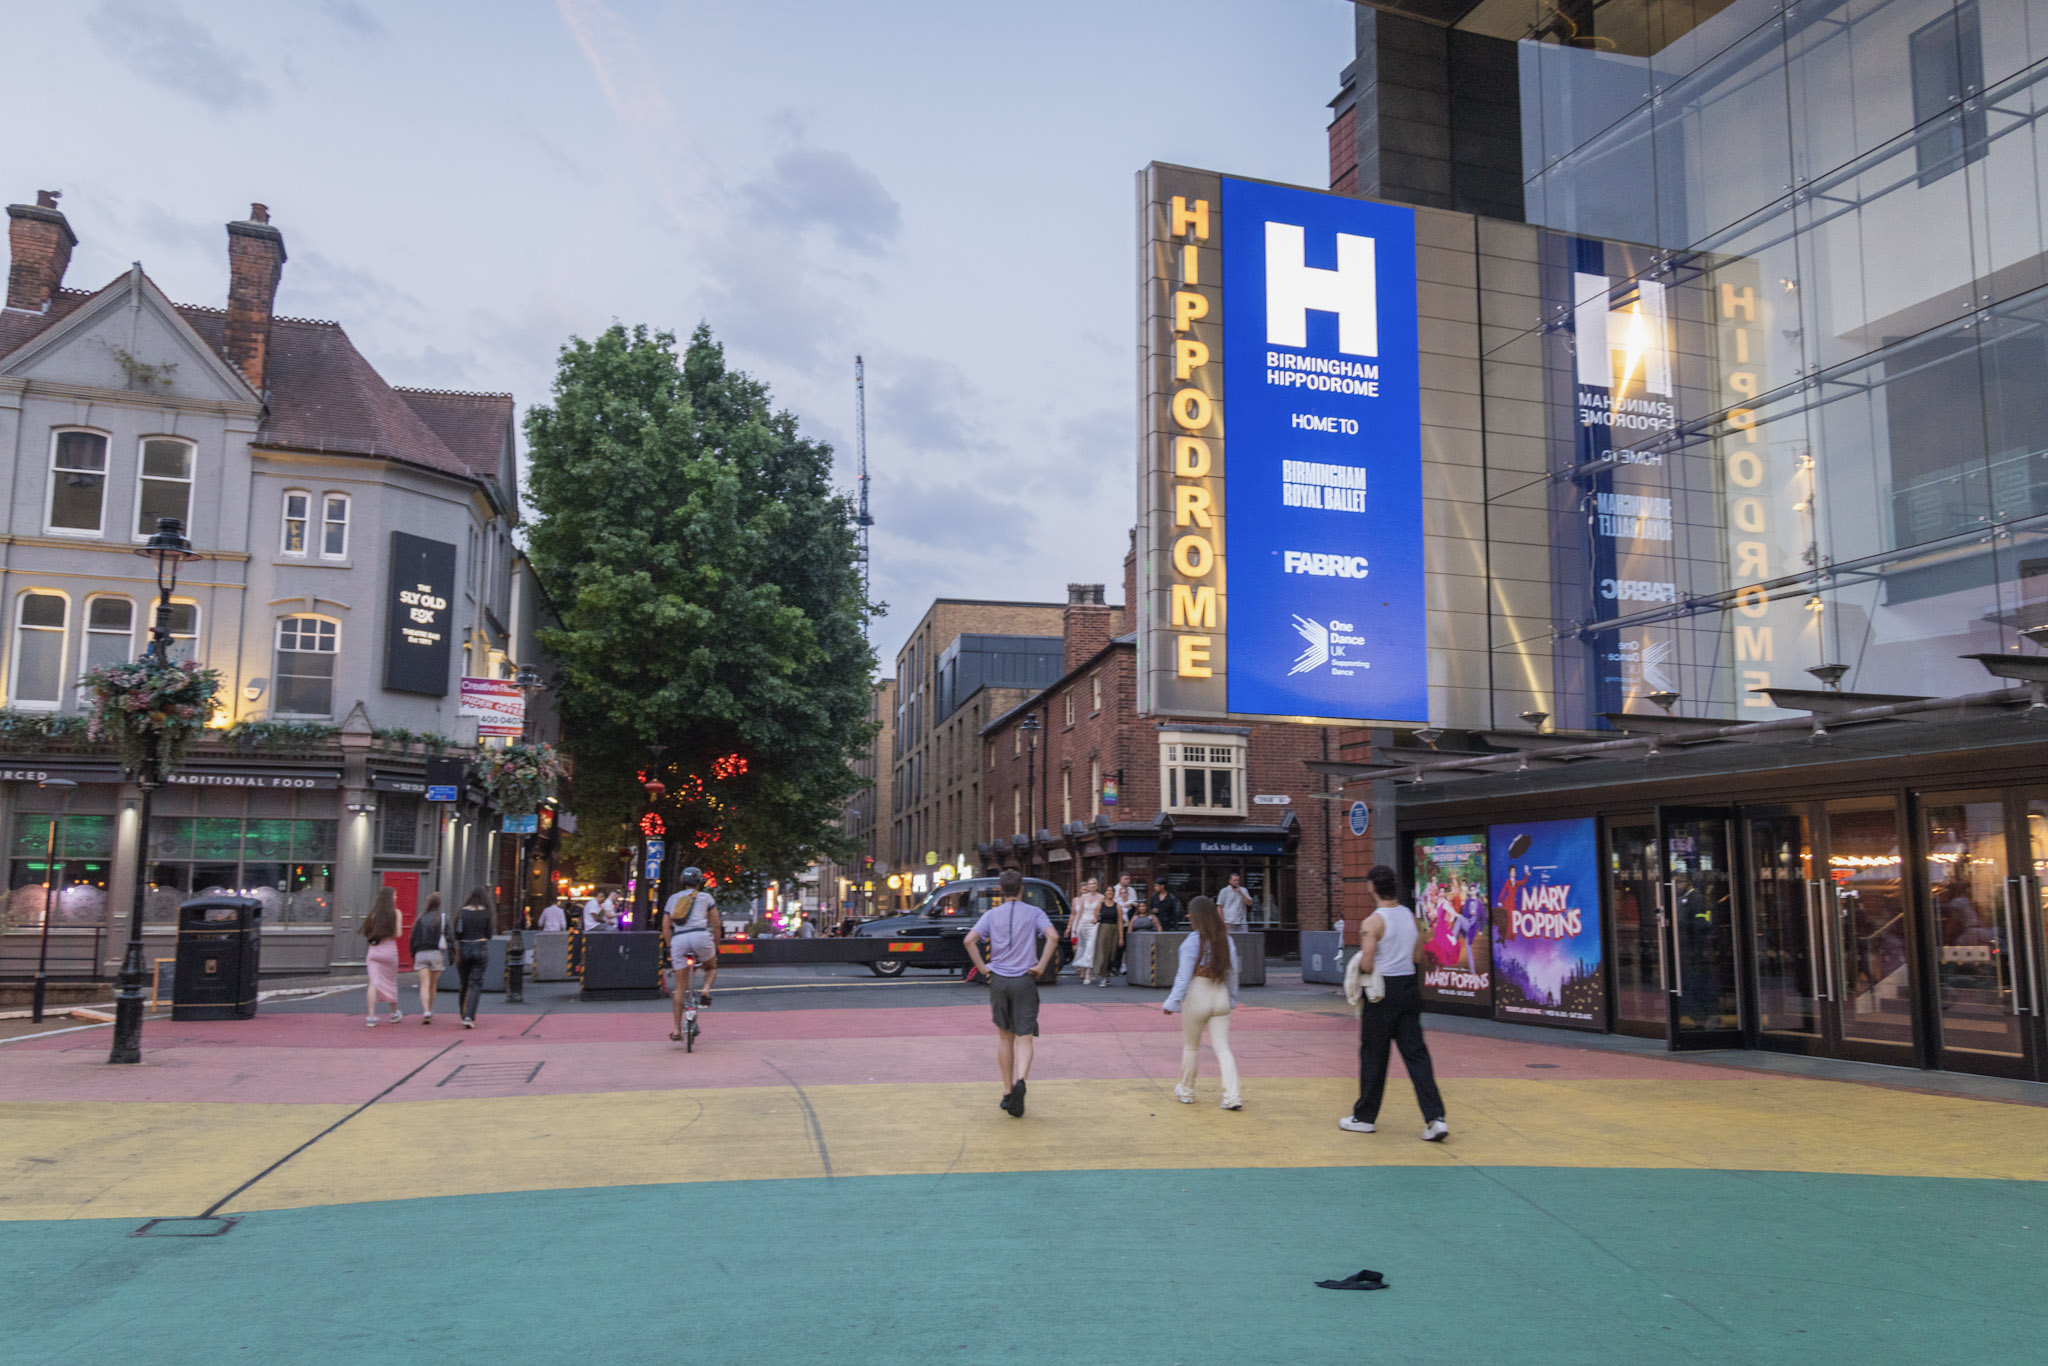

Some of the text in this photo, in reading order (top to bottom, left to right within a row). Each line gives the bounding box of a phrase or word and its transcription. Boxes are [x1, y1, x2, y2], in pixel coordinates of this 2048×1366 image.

[1265, 220, 1379, 358] H
[1266, 351, 1379, 380] BIRMINGHAM
[1266, 369, 1380, 398] HIPPODROME
[1291, 413, 1359, 435] HOME TO
[1171, 196, 1216, 678] HIPPODROME
[1282, 459, 1367, 490] BIRMINGHAM
[1283, 482, 1367, 513] ROYAL BALLET
[1284, 550, 1369, 579] FABRIC
[399, 591, 447, 610] SLY OLD
[410, 607, 435, 624] FOX
[1329, 620, 1354, 632] One
[1330, 632, 1366, 645] Dance
[1330, 645, 1346, 656] UK
[166, 775, 316, 788] RADITIONAL FOOD
[1201, 843, 1219, 851] Back
[1230, 844, 1254, 852] Backs
[1521, 884, 1571, 912] MARY
[1511, 908, 1582, 940] POPPINS
[1424, 970, 1490, 990] MARY POPPINS
